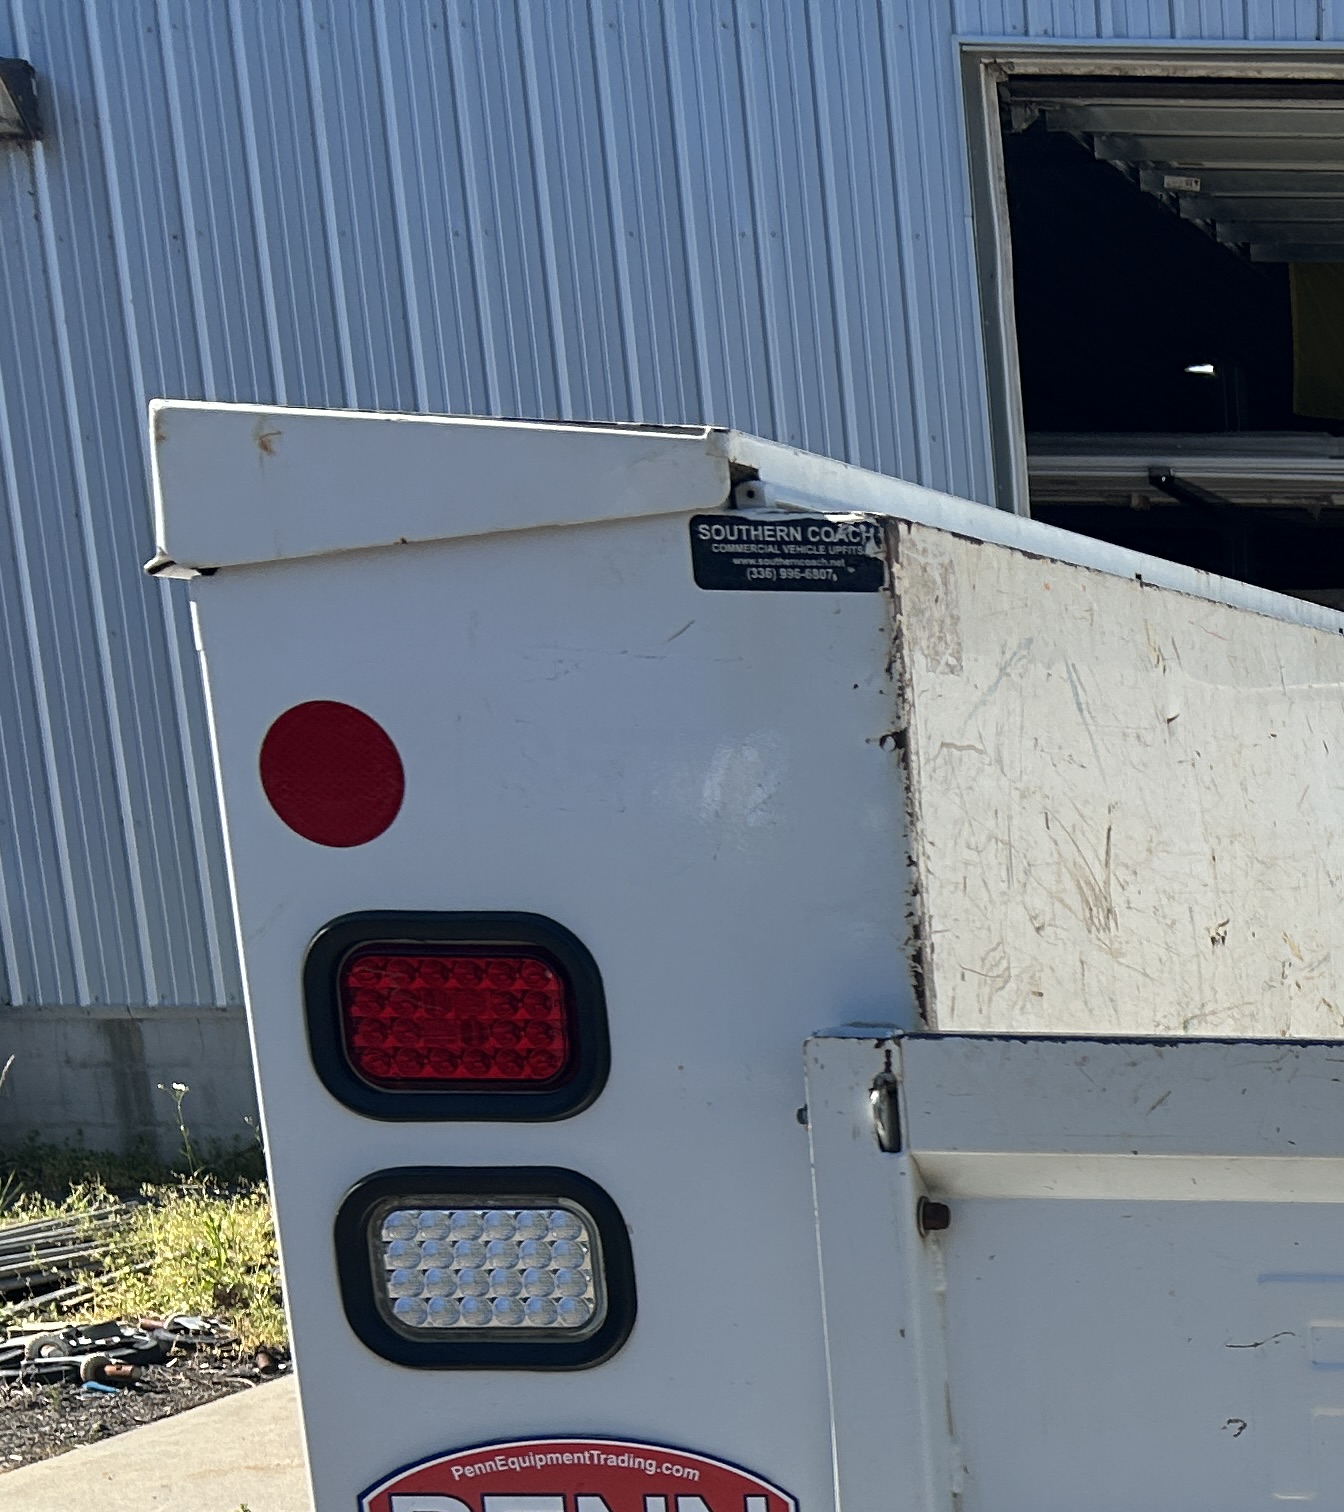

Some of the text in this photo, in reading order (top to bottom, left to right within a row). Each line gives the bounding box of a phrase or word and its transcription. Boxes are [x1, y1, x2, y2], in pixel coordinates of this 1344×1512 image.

[698, 524, 875, 543] SOUTHERN COACH
[711, 543, 780, 554] COMMERCIAL
[782, 544, 826, 555] VEHICLE
[746, 567, 777, 581] (336)
[450, 1450, 702, 1482] PennEquipmentTrading.com
